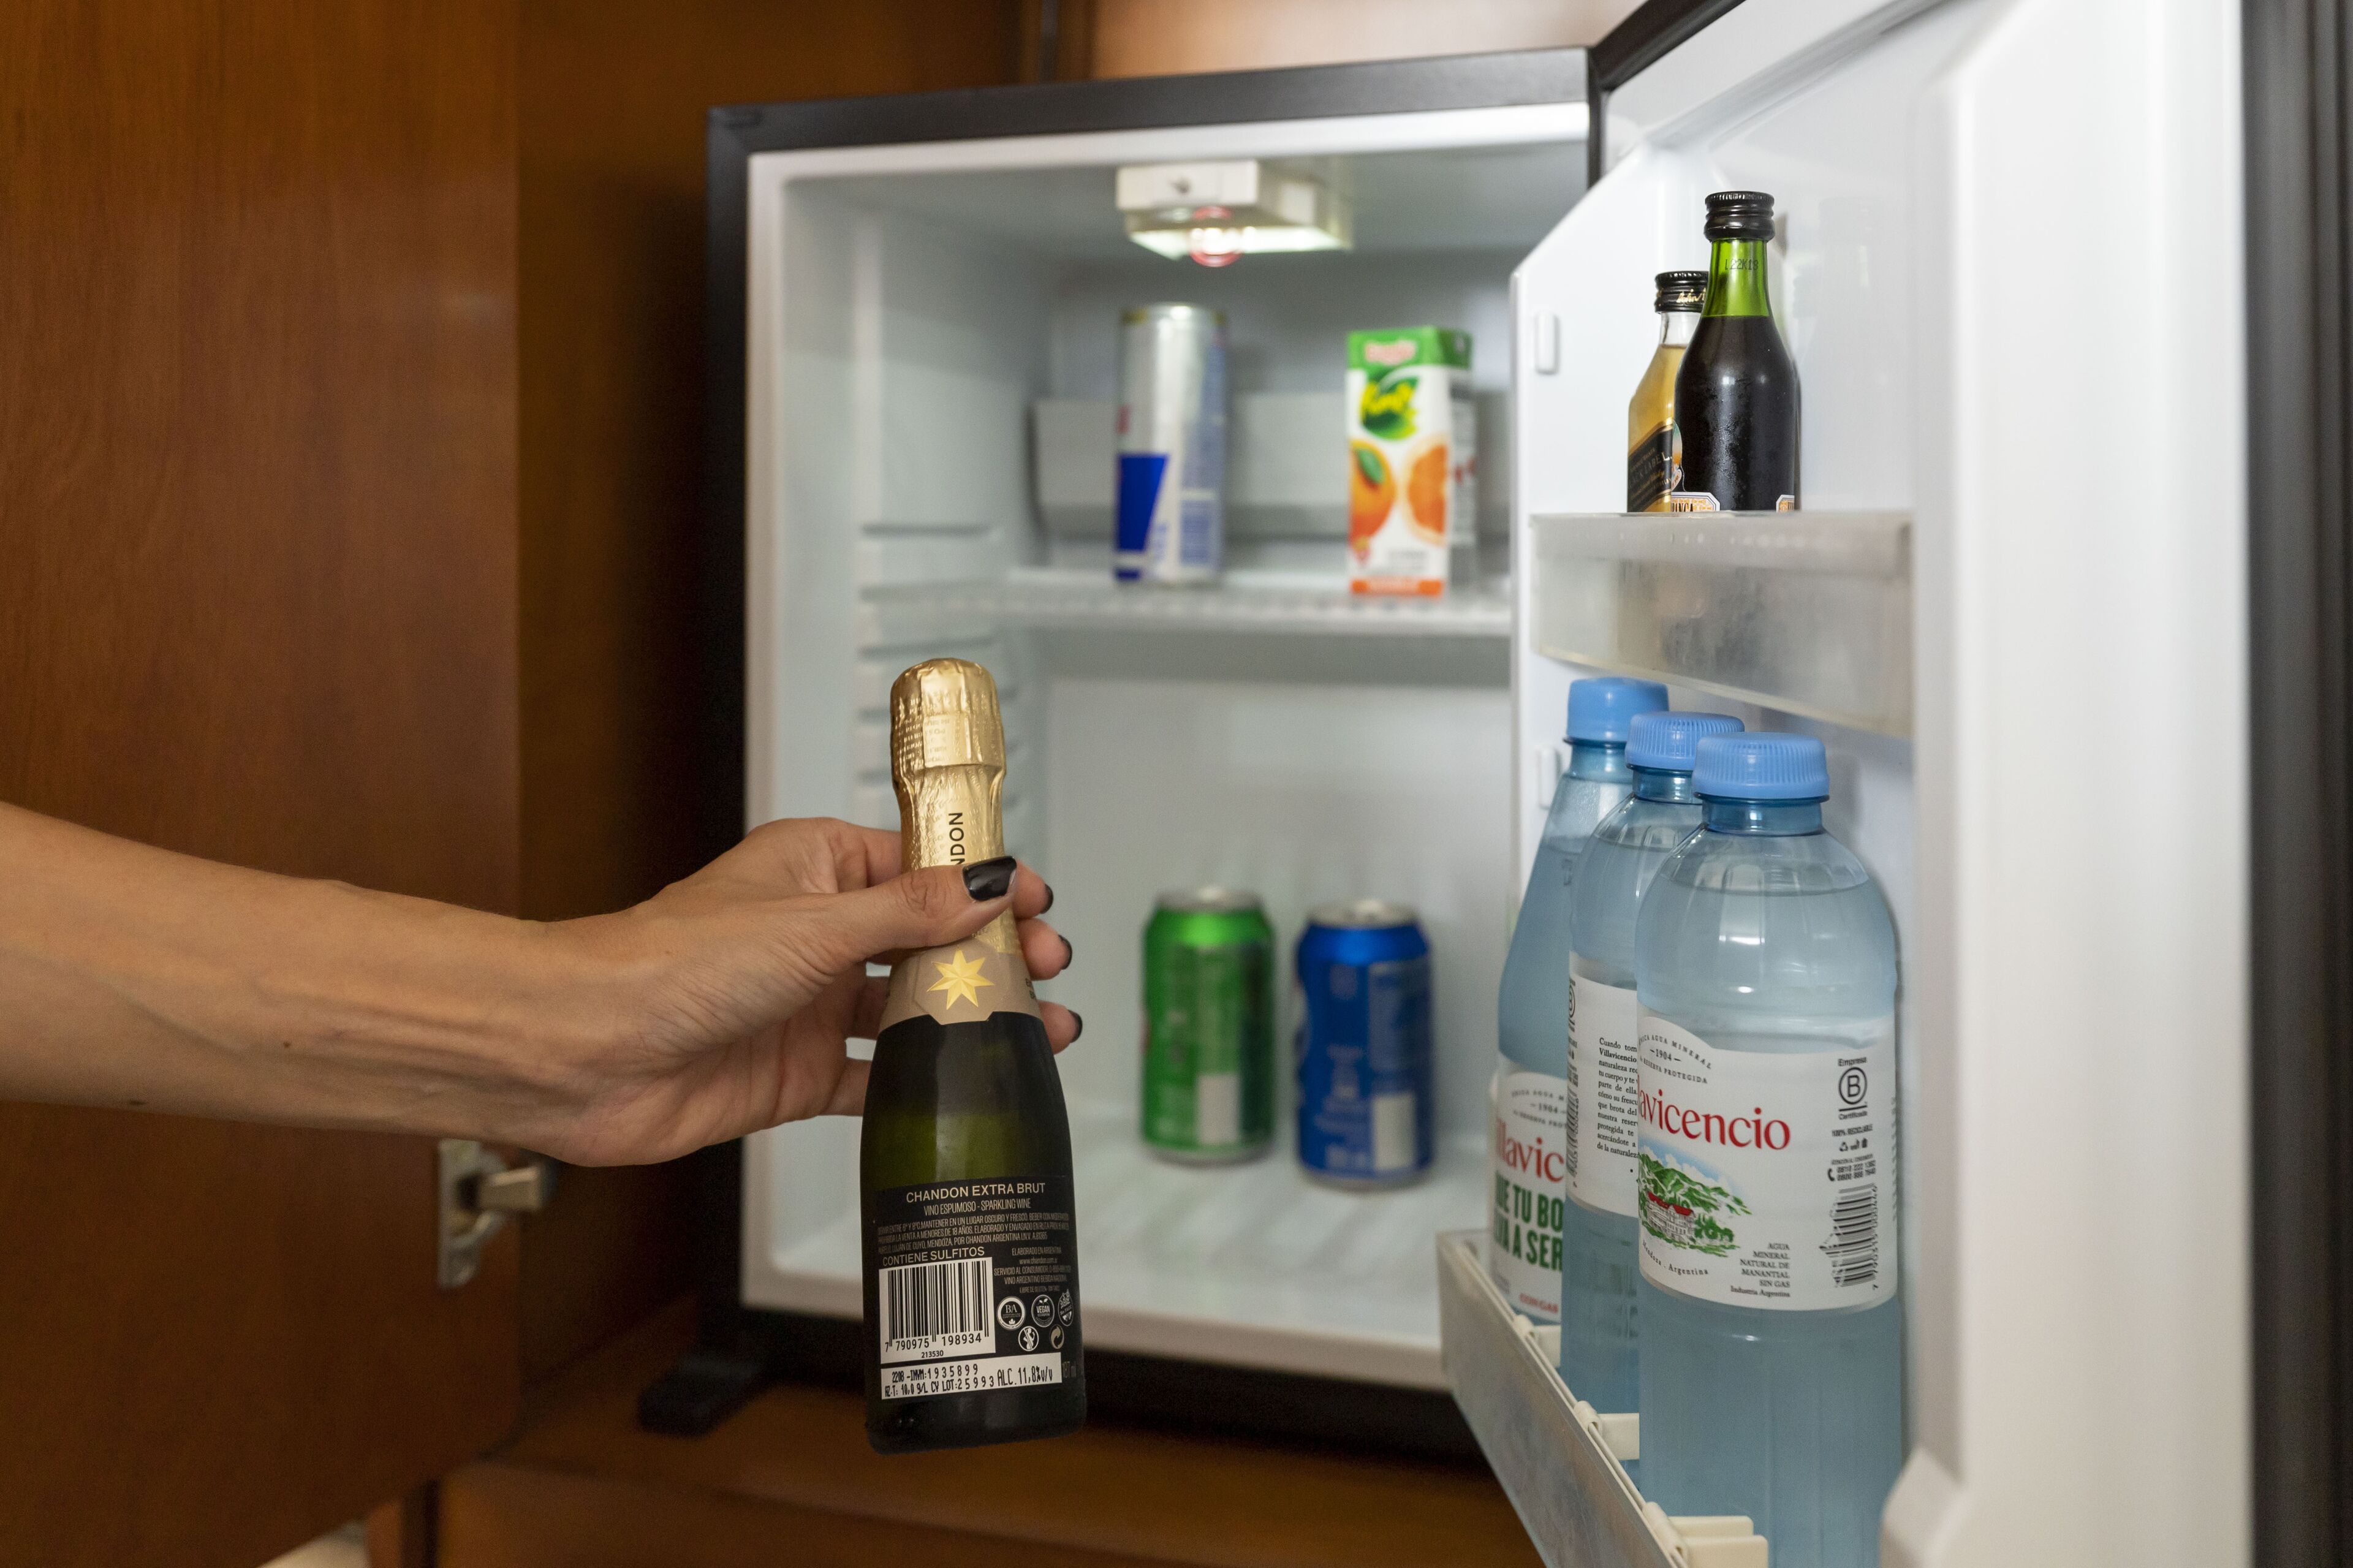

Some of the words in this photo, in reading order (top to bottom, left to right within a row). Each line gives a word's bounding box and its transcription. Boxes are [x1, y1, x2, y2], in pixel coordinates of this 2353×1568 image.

[949, 812, 966, 866] NDON
[1599, 1037, 1621, 1049] Cuando
[1599, 1047, 1637, 1062] Villavicencio
[1599, 1060, 1627, 1072] naturaleza
[1605, 1072, 1623, 1082] cuerpo
[1664, 1068, 1707, 1084] PROTEGIDA
[1599, 1081, 1612, 1089] parte
[1598, 1091, 1612, 1100] cómo
[1621, 1096, 1638, 1105] frescu
[1610, 1104, 1624, 1113] brota
[1598, 1112, 1617, 1122] nuestra
[1597, 1123, 1623, 1135] protegida
[1597, 1133, 1629, 1146] acercándote
[1597, 1142, 1603, 1150] de
[906, 1186, 969, 1203] CHANDON
[972, 1184, 1014, 1196] EXTRA
[1017, 1183, 1046, 1194] BRUT
[923, 1203, 939, 1216] VINO
[940, 1200, 976, 1214] ESPUMOSO
[981, 1199, 1015, 1211] SPARKLING
[1016, 1198, 1031, 1208] WINE
[1512, 1184, 1532, 1223] TU
[1537, 1194, 1563, 1233] BO
[950, 1217, 957, 1226] EN
[957, 1216, 965, 1225] UN
[966, 1214, 983, 1225] LUGAR
[984, 1214, 1005, 1223] OSCURO
[920, 1229, 944, 1238] MENORES
[958, 1225, 974, 1235] AÑOS.
[974, 1224, 1004, 1234] ELABORADO
[1009, 1222, 1033, 1231] ENVASADO
[927, 1238, 953, 1248] MENDOZA,
[954, 1237, 964, 1245] POR
[966, 1234, 991, 1244] CHANDON
[992, 1233, 1020, 1242] ARGENTINA
[882, 1251, 928, 1267] CONTIENE
[930, 1246, 985, 1260] SULFITOS
[1012, 1247, 1037, 1256] ELABORADO
[994, 1267, 1015, 1276] SERVICIO
[1669, 1263, 1708, 1276] Argentina
[1004, 1276, 1015, 1285] VINO
[1016, 1275, 1040, 1284] ARGENTINO
[1036, 1305, 1050, 1314] VEGAN
[885, 1342, 889, 1352] 7
[896, 1338, 930, 1351] 790975
[942, 1333, 981, 1346] 198934
[921, 1350, 944, 1358] 213530
